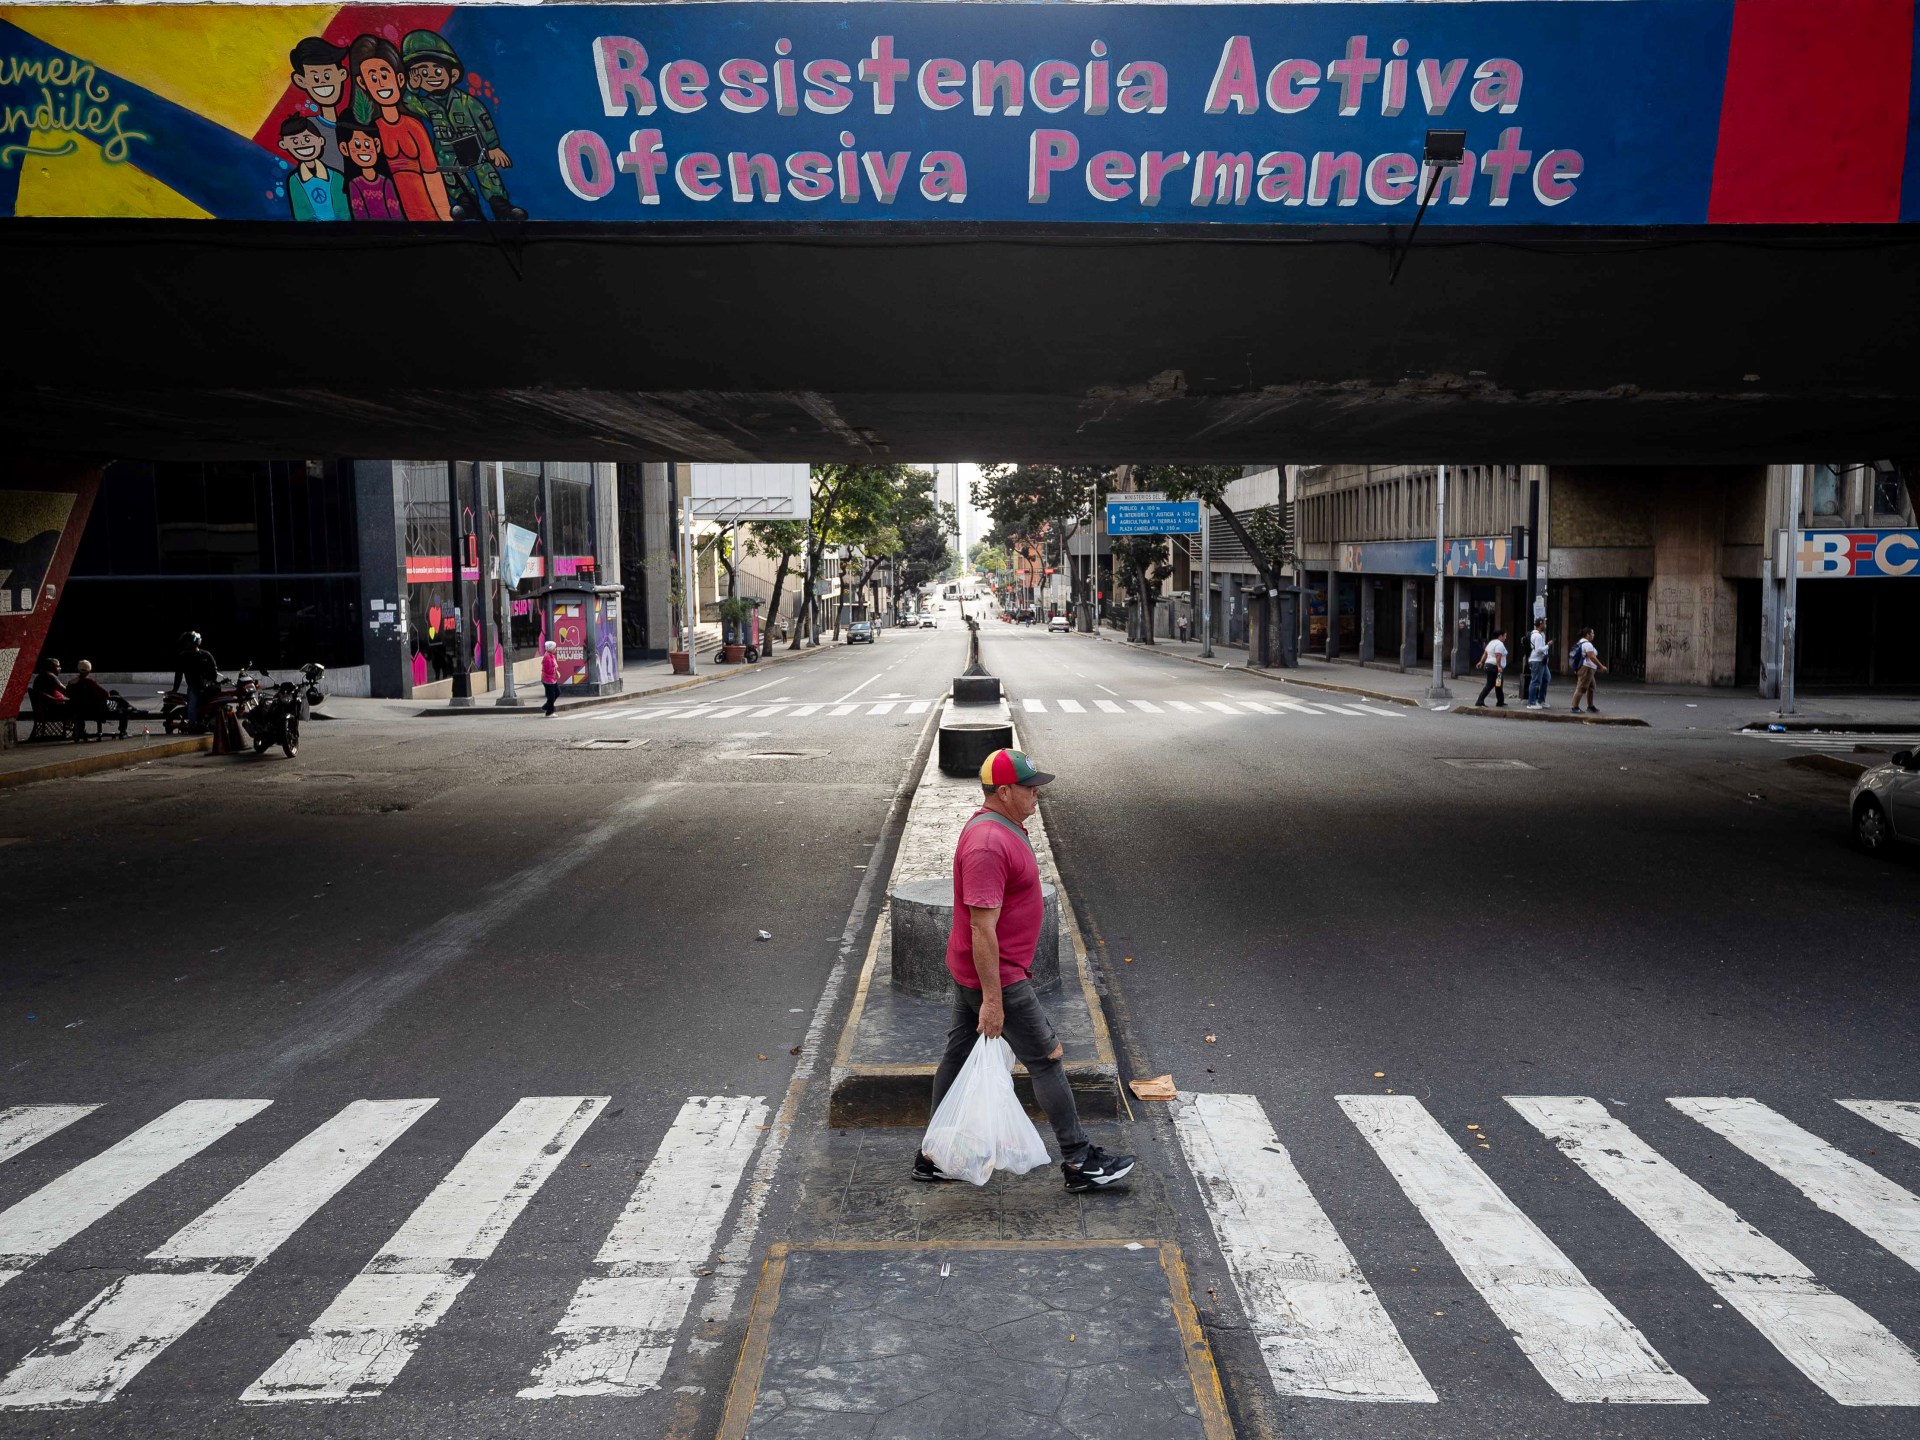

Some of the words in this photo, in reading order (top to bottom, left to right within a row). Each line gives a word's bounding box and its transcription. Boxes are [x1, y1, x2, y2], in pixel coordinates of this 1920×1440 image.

[592, 35, 1168, 116] Resistencia
[1204, 35, 1523, 116] Activa
[557, 128, 968, 206] Ofensiva
[1028, 127, 1585, 207] Permanente
